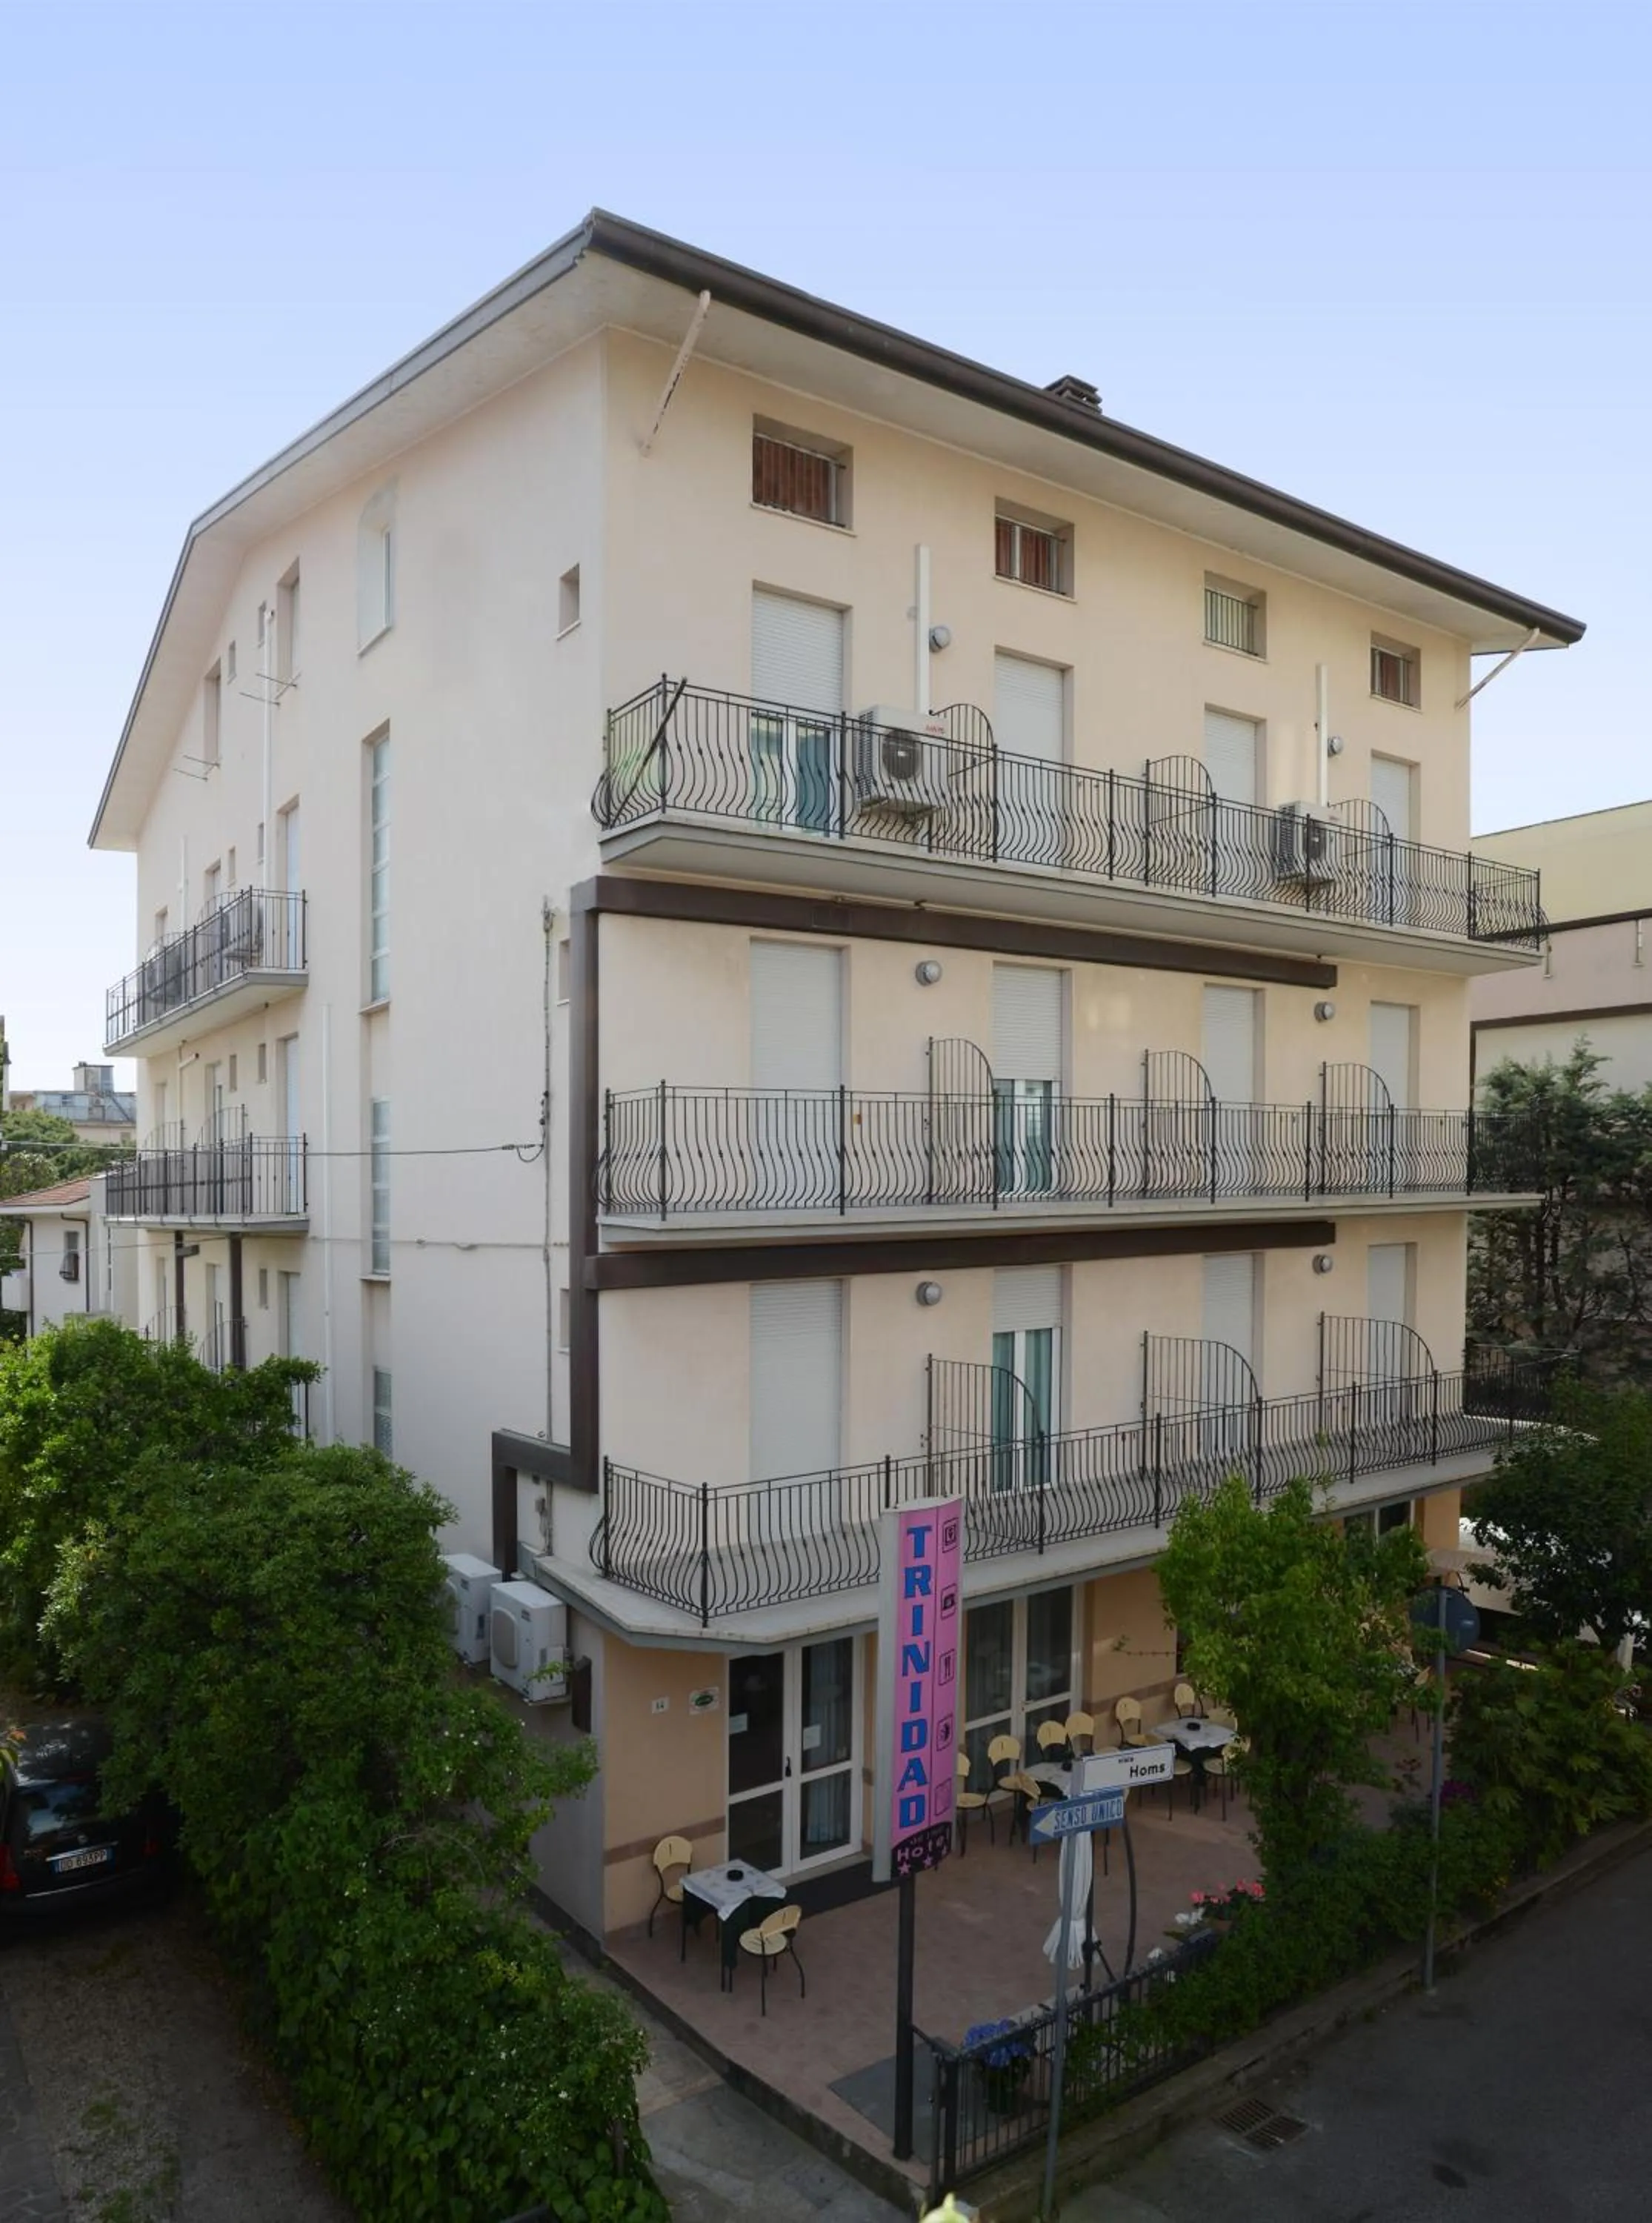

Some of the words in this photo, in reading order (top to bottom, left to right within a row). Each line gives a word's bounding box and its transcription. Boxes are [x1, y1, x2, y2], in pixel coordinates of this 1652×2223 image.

[897, 1524, 933, 1830] TRINIDAD
[1130, 1763, 1165, 1778] Homs
[1054, 1806, 1087, 1830] SENSO
[1091, 1798, 1122, 1821] UNICO
[897, 1826, 950, 1862] Hotel
